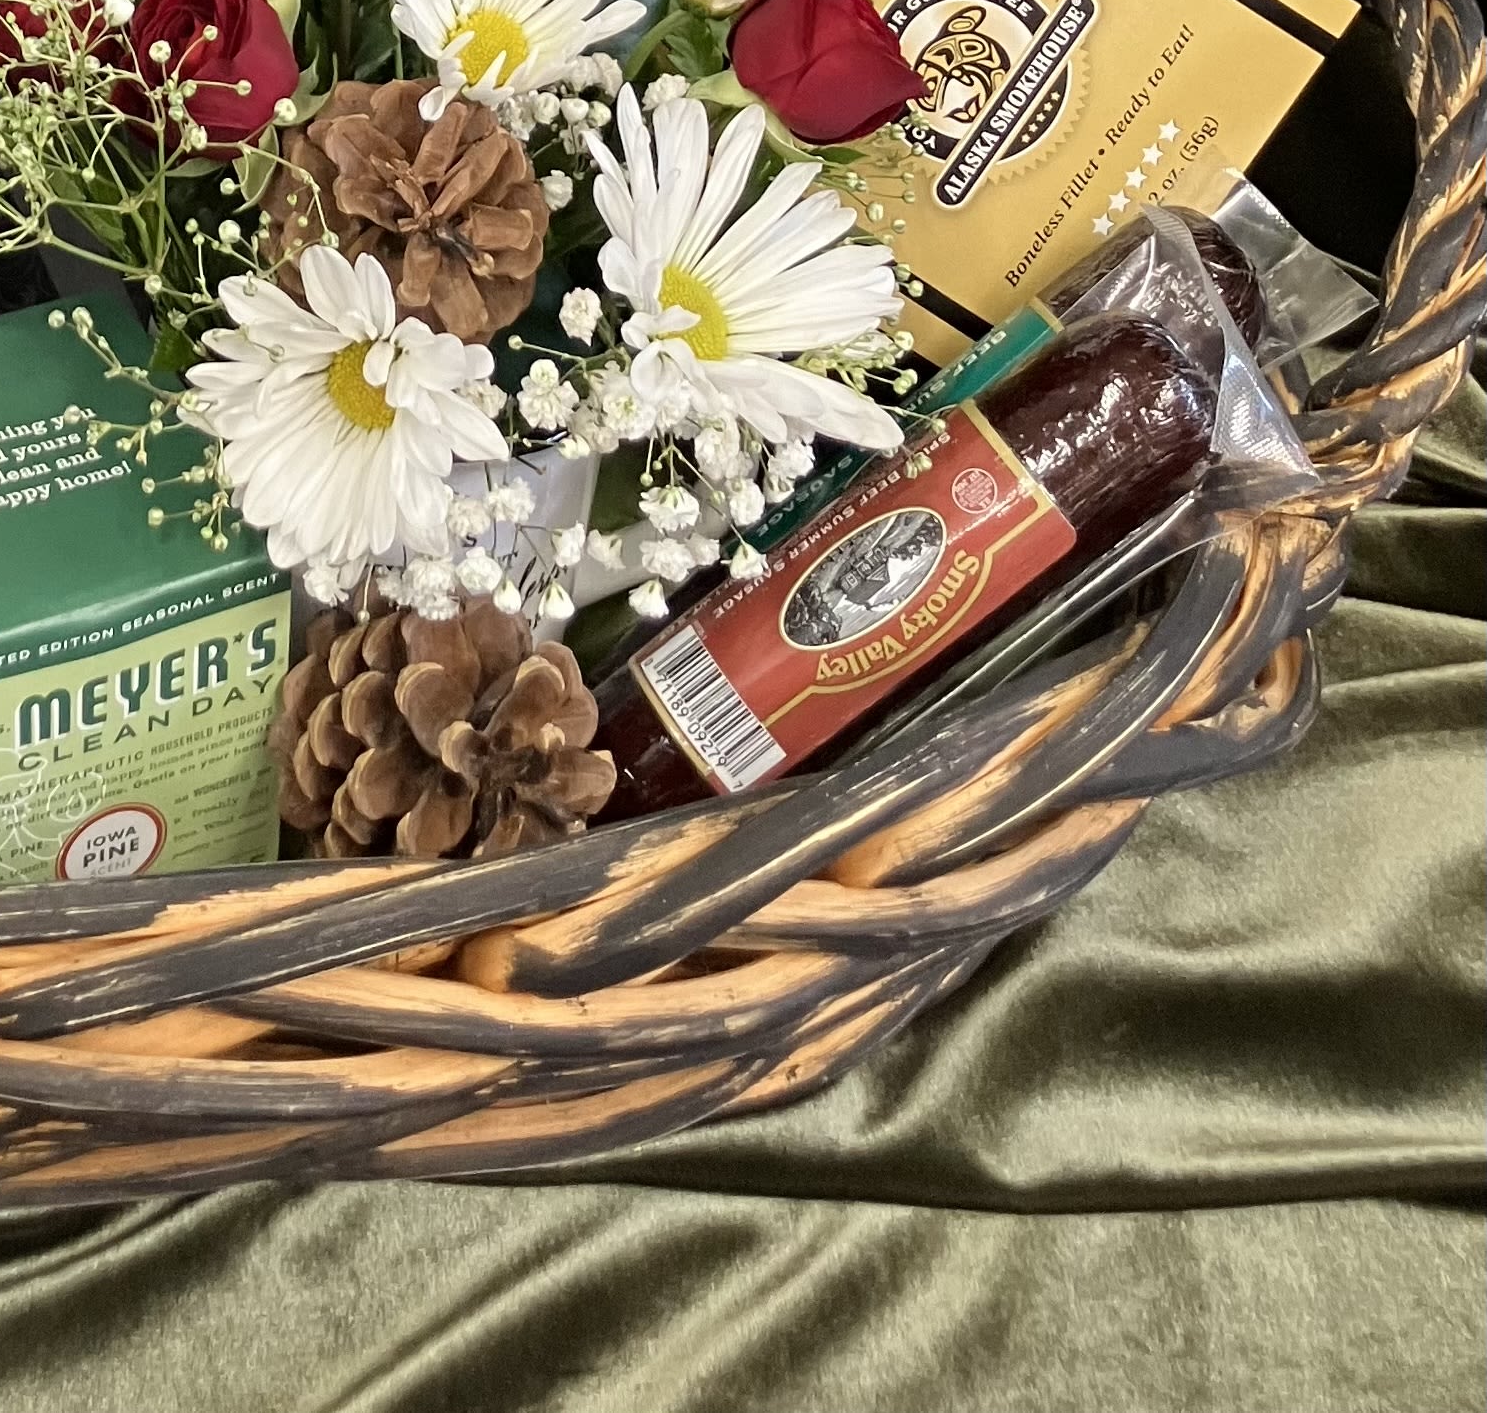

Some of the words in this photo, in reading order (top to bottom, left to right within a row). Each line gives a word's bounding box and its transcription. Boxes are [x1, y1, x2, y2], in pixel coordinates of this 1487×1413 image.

[944, 131, 1000, 201] ALASKA
[1004, 211, 1065, 288] Boneless
[1060, 156, 1100, 210] Fillet
[1105, 86, 1151, 147] Ready
[1148, 67, 1165, 87] to
[1162, 23, 1195, 68] Eat!
[1162, 166, 1185, 191] oz.
[1178, 116, 1219, 162] (56g)
[954, 329, 1007, 375] BEEF
[51, 407, 97, 431] yu
[11, 432, 82, 462] yours
[56, 446, 103, 470] and
[54, 460, 132, 491] home!
[756, 455, 854, 537] SAUSAGE
[859, 470, 901, 507] BEEF
[789, 506, 856, 560] SUMMER
[38, 626, 115, 656] EDITION
[121, 594, 215, 633] SEASONAL
[222, 572, 279, 598] SCENT
[712, 560, 785, 619] SAUSAGE
[900, 549, 980, 641] Smoky
[816, 634, 908, 681] Valley
[18, 709, 170, 772] CLEAN
[192, 674, 274, 717] DAY
[150, 727, 214, 756] HOUSEHOLD
[218, 705, 274, 734] PRODUCTS
[655, 675, 689, 717] 71189
[687, 722, 727, 767] 09279
[133, 769, 175, 790] Gentle
[200, 752, 229, 770] your
[82, 837, 140, 868] PINE
[86, 826, 137, 850] IOWA
